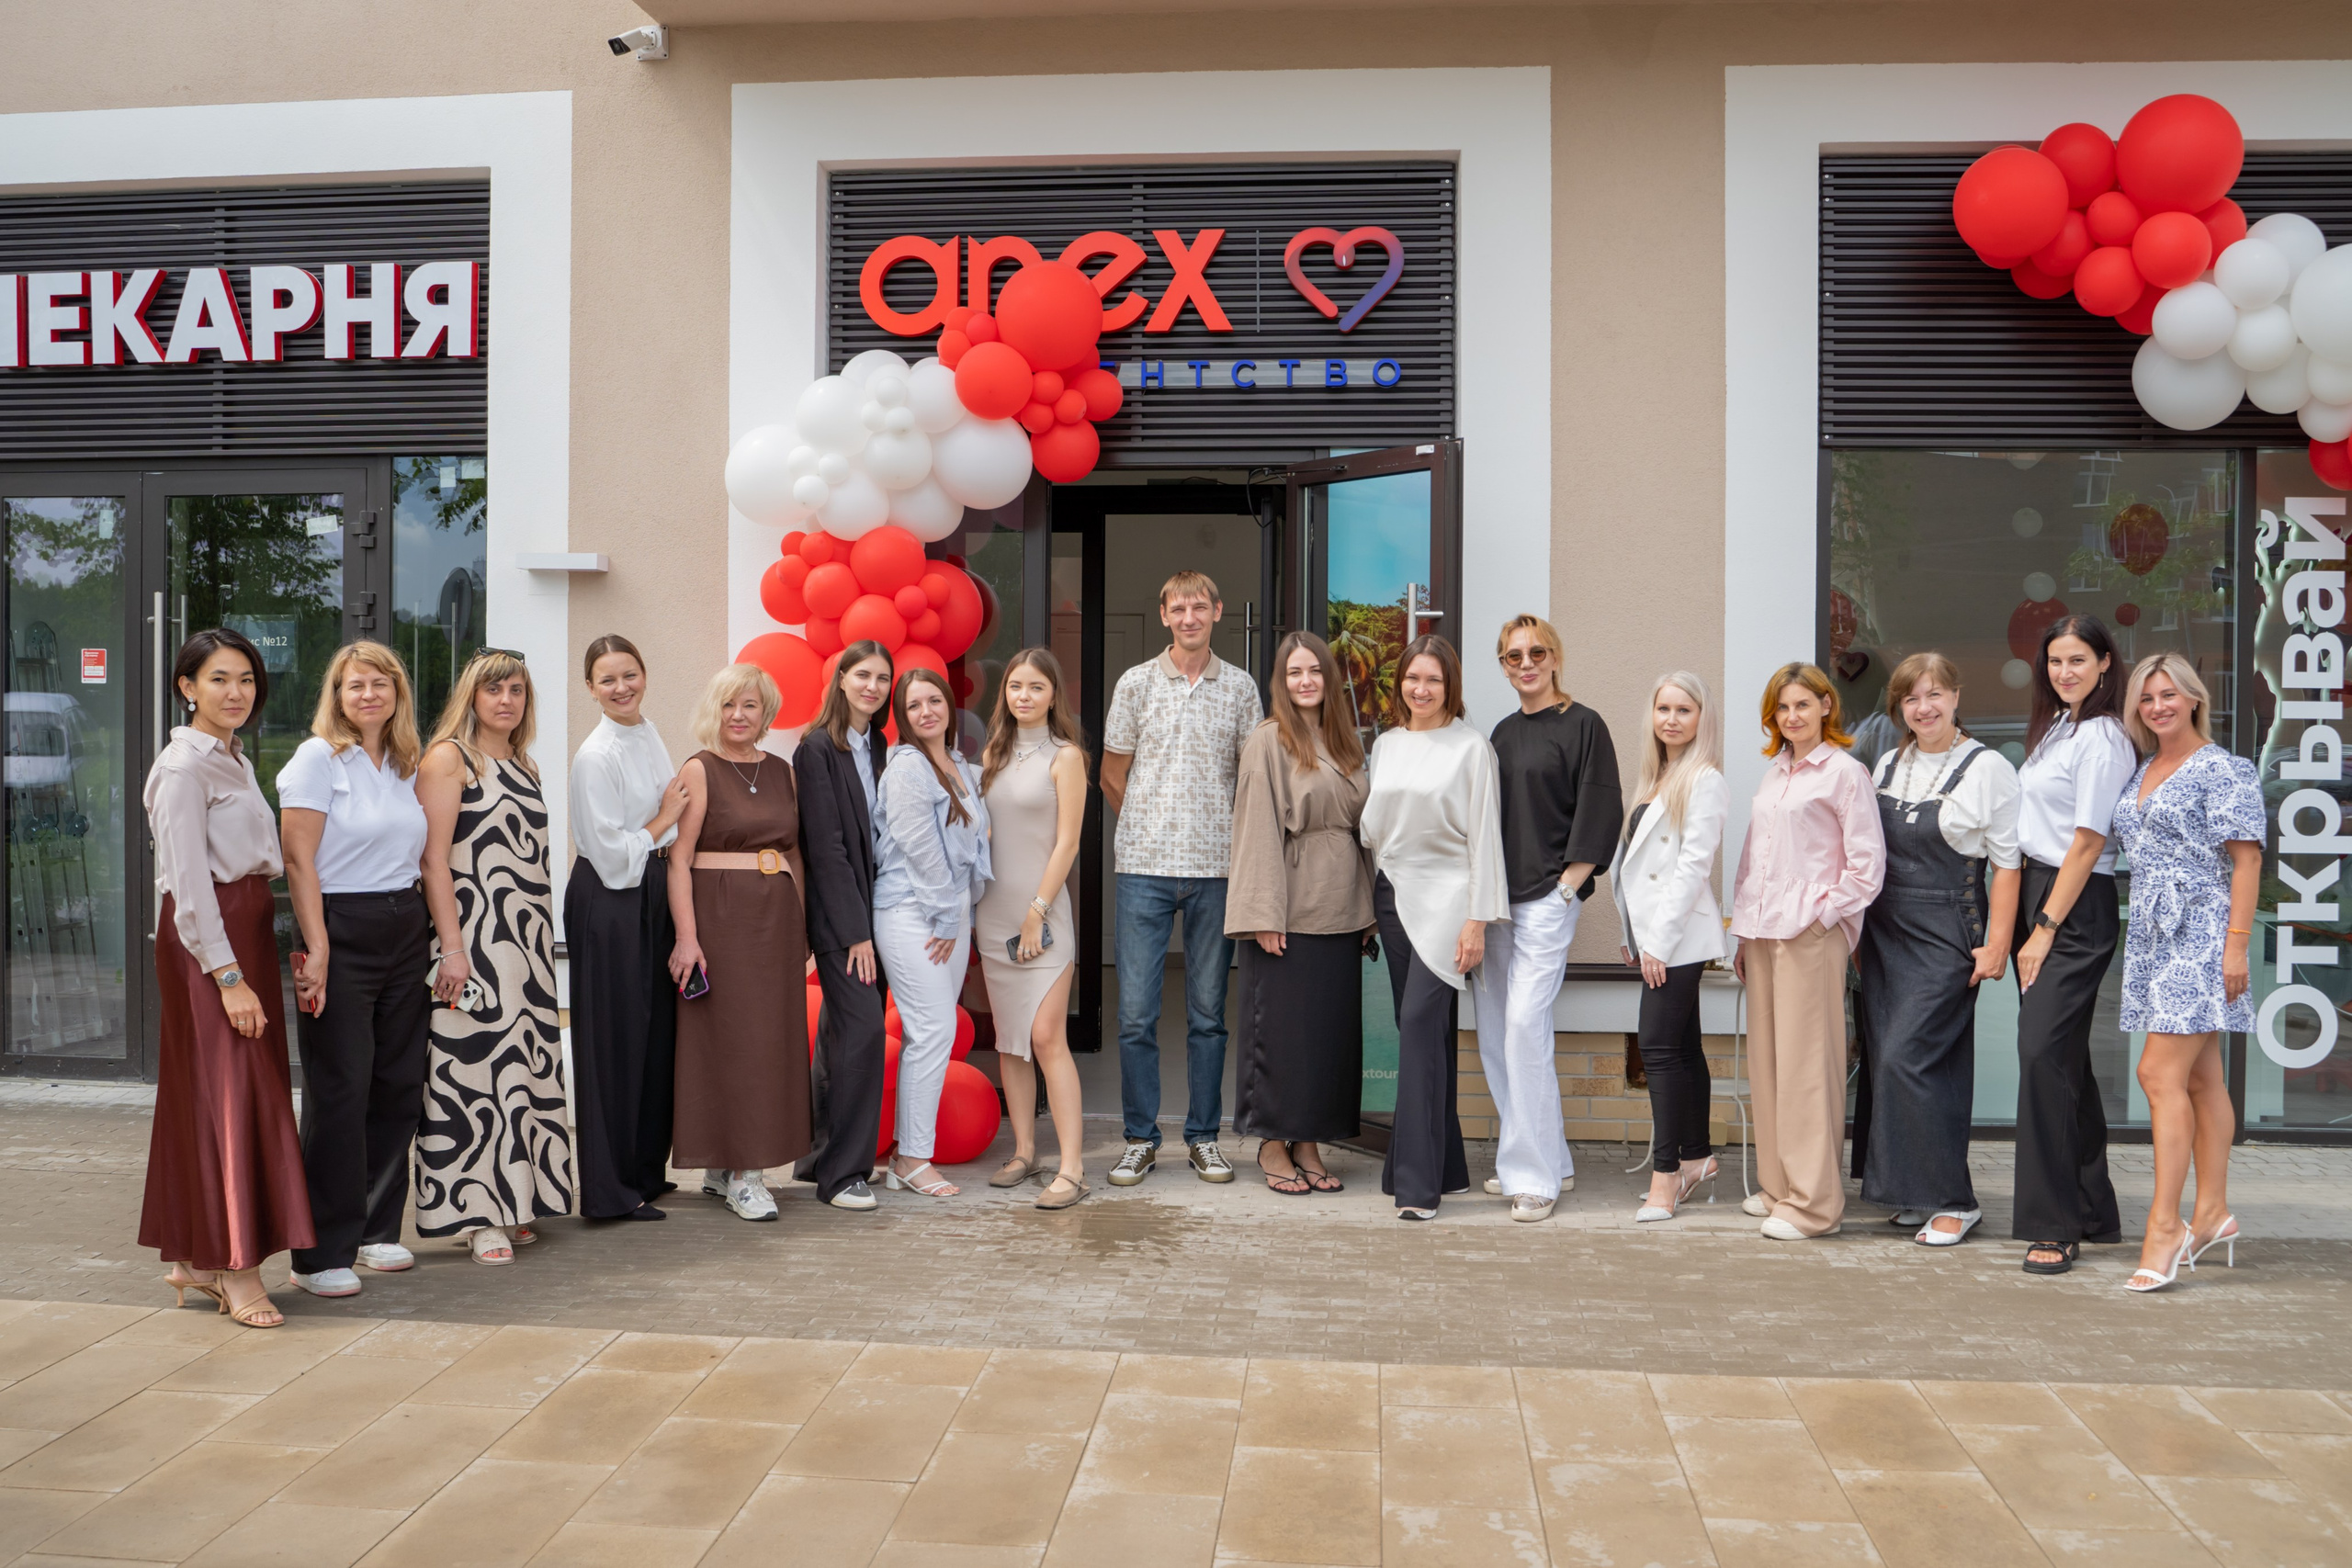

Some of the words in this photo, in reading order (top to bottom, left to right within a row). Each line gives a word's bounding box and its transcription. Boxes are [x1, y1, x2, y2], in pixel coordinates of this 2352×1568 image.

[1100, 357, 1402, 389] НТСТВО
[263, 636, 288, 647] №12
[2256, 496, 2352, 1069] Открывай
